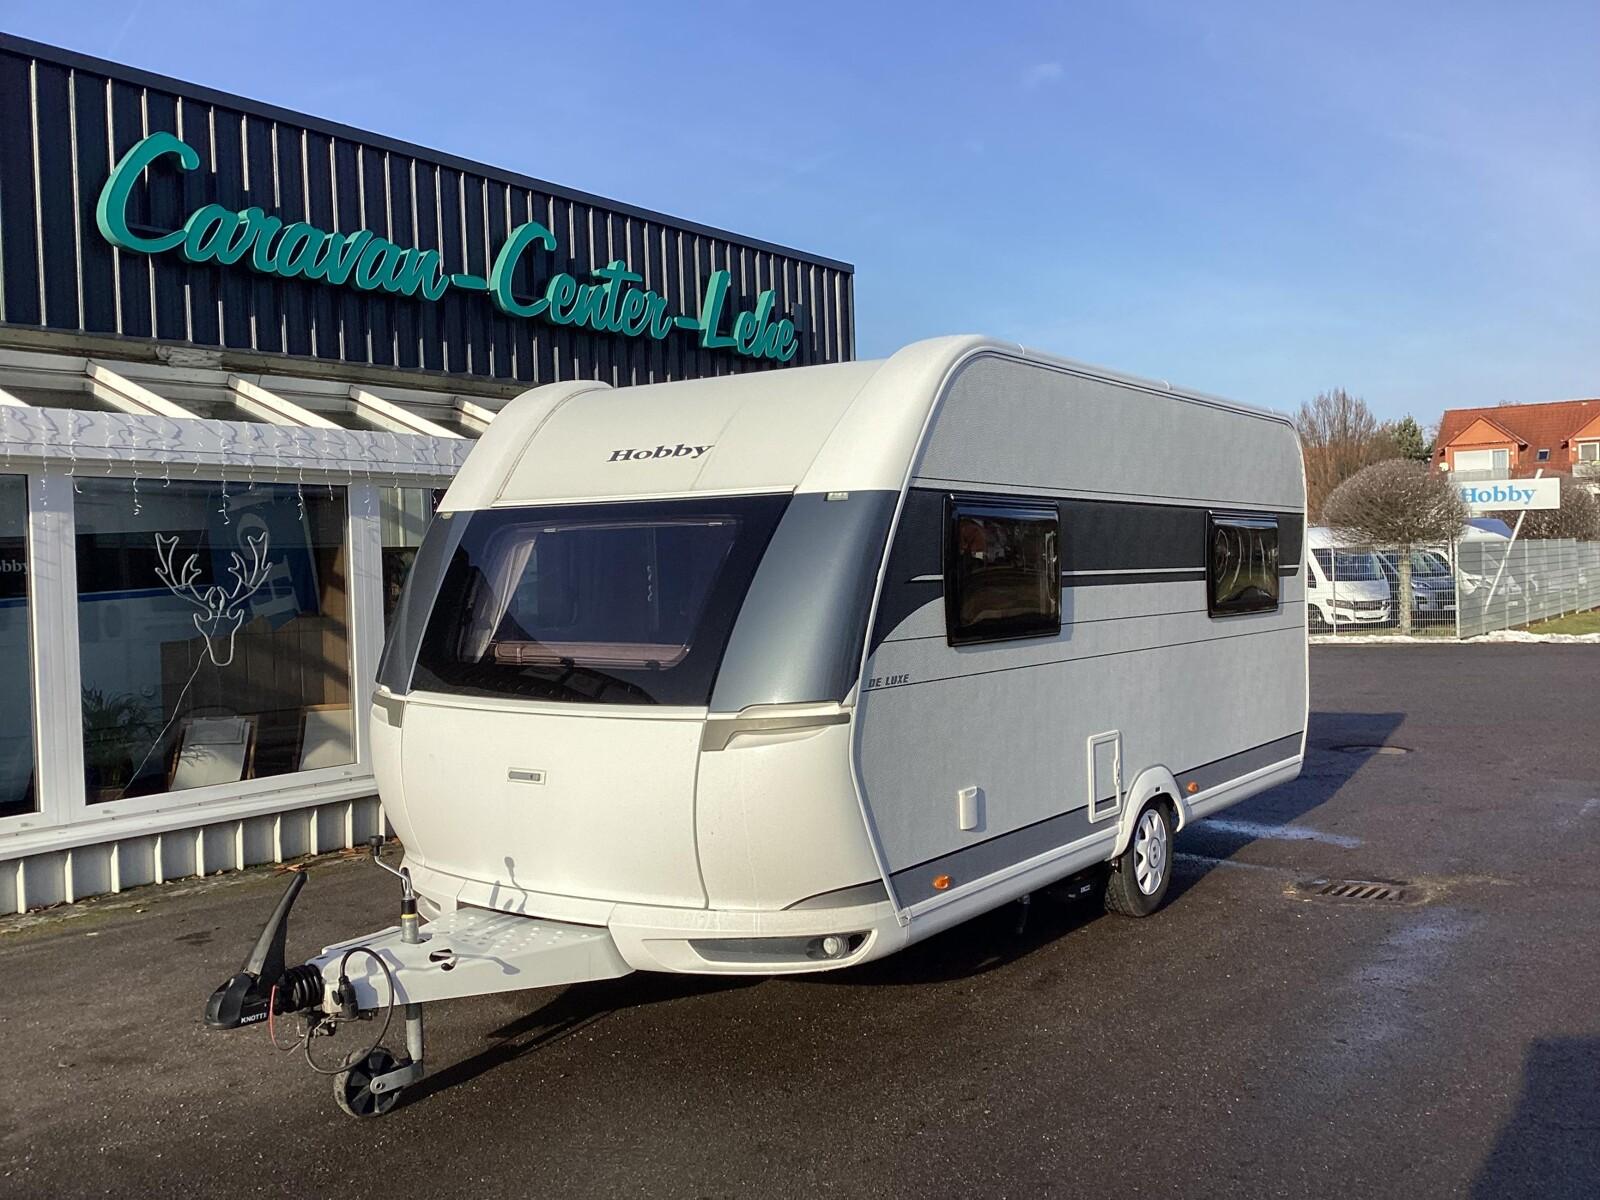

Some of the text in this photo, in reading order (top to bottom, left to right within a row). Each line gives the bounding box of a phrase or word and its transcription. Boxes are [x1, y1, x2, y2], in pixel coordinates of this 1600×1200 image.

[606, 443, 715, 463] Hobby
[1460, 485, 1536, 505] Hobby
[868, 673, 909, 688] DE LUXE
